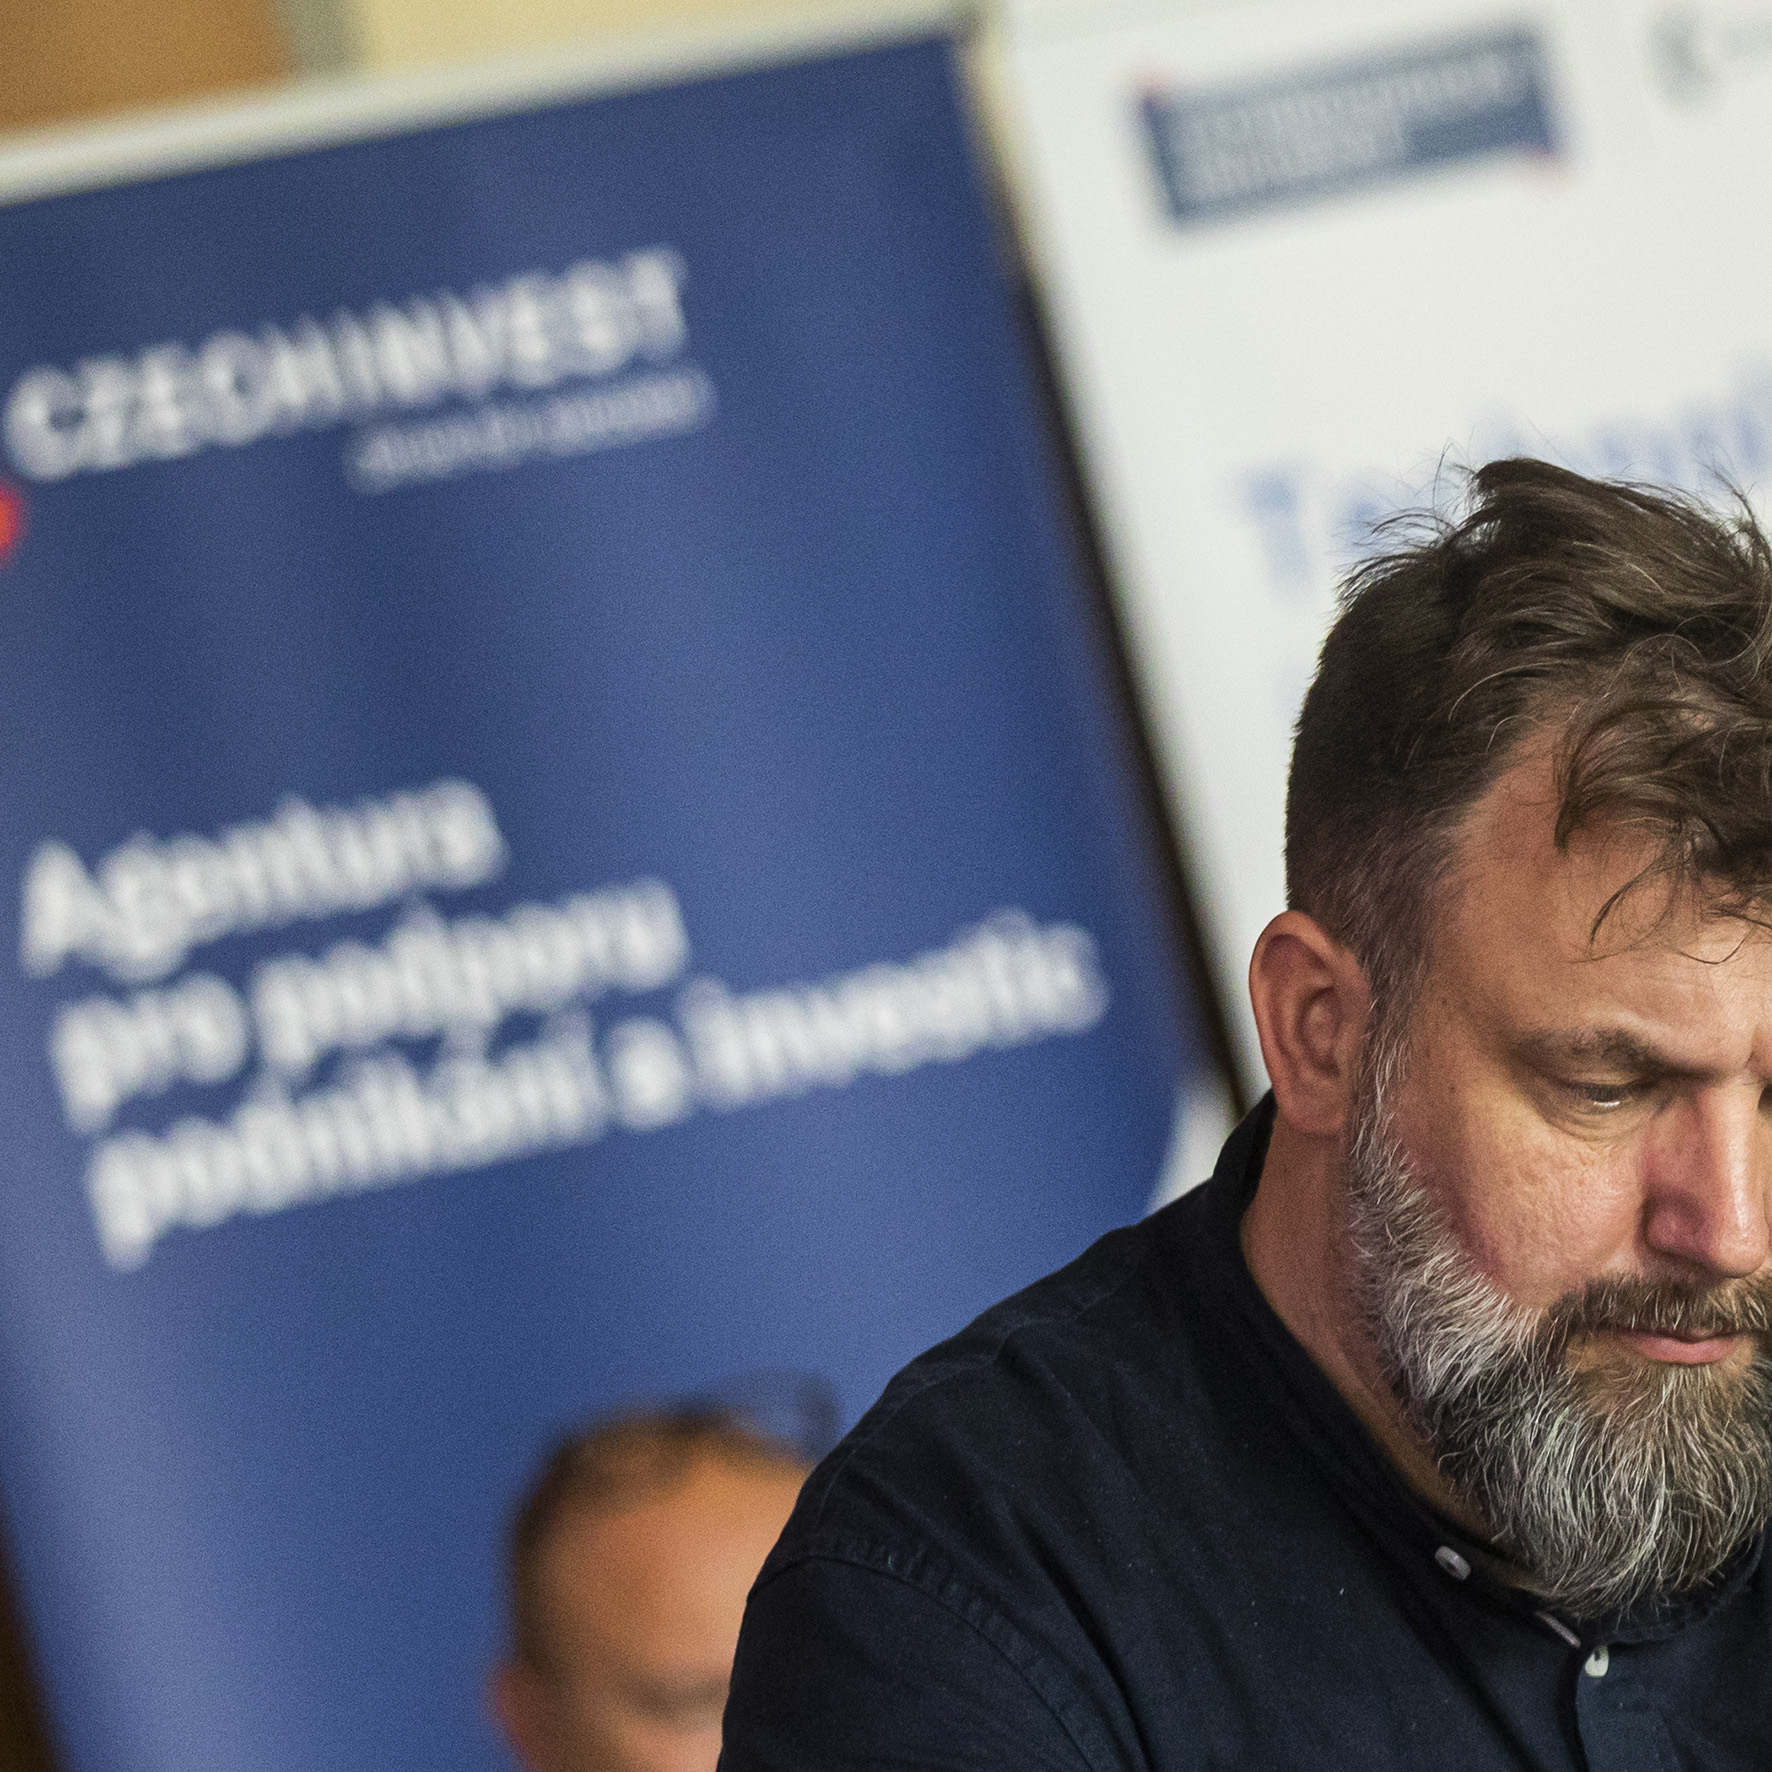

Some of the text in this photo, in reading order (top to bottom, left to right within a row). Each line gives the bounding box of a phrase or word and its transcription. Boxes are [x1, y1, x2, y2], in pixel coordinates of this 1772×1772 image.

[9, 244, 687, 478] CZECHINVEST
[25, 778, 504, 980] Agentura
[56, 879, 686, 1130] pro podporu
[91, 910, 1105, 1268] podnikání a investic
